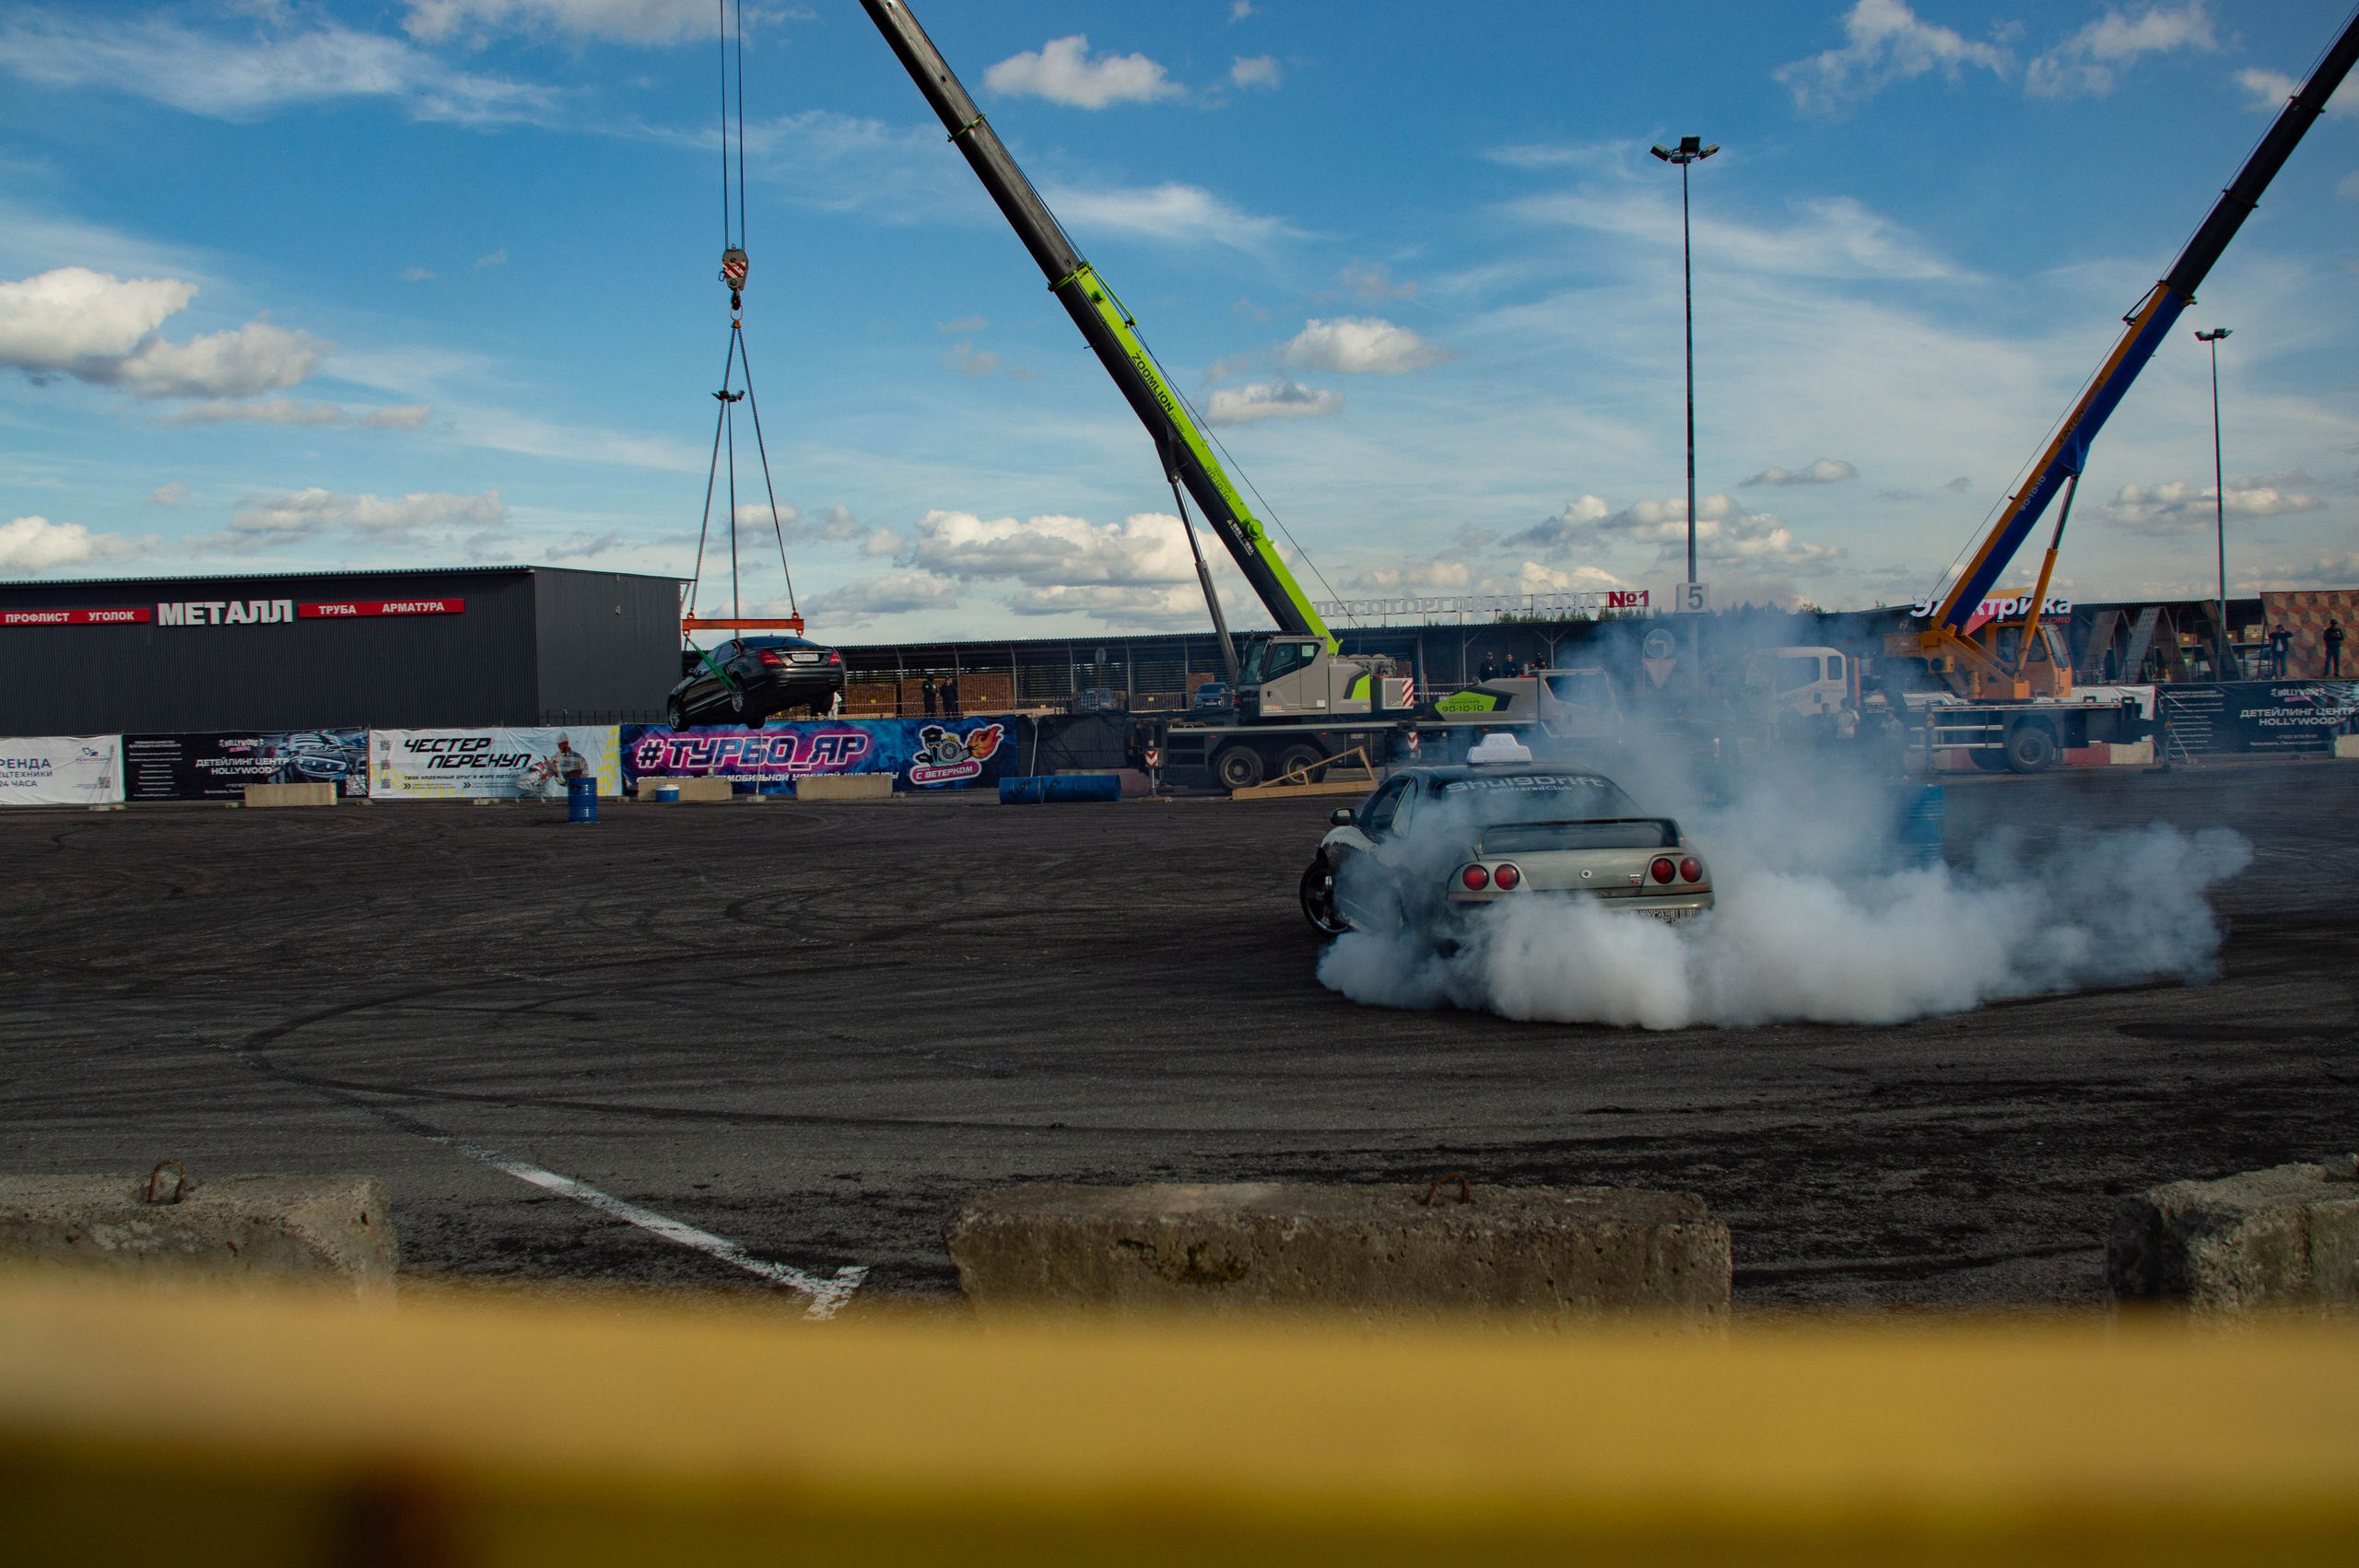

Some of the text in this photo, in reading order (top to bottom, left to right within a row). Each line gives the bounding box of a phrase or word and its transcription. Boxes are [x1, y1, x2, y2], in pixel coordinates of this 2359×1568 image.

[1132, 352, 1175, 413] ZOOMLION
[1205, 465, 1231, 502] 90-10-10
[2019, 475, 2047, 511] 90-10-10
[1531, 591, 1601, 612] БАЗА
[1608, 590, 1649, 608] №1
[1687, 585, 1704, 610] 5
[158, 600, 293, 626] МЕТАЛЛ
[318, 602, 445, 615] ТРУБА АРМАТУРА
[1908, 592, 2072, 623] Эктрика
[5, 611, 135, 623] ПРОФЛИСТ УГОЛОК
[2240, 707, 2355, 719] ДЕТЕЙЛИНГ ЦЕНТР
[2259, 717, 2337, 726] HOLLYWOOD
[404, 737, 492, 753] ЧЕСТЕР
[636, 734, 868, 772] #ТУРБО_ЯР
[195, 756, 290, 768] ДЕТЕЙЛИНГ ЦЕНТР
[427, 753, 532, 769] ПЕРЕКУП
[211, 766, 273, 775] HOLLYWOOD
[924, 766, 973, 778] ВЕТЕРКОМ
